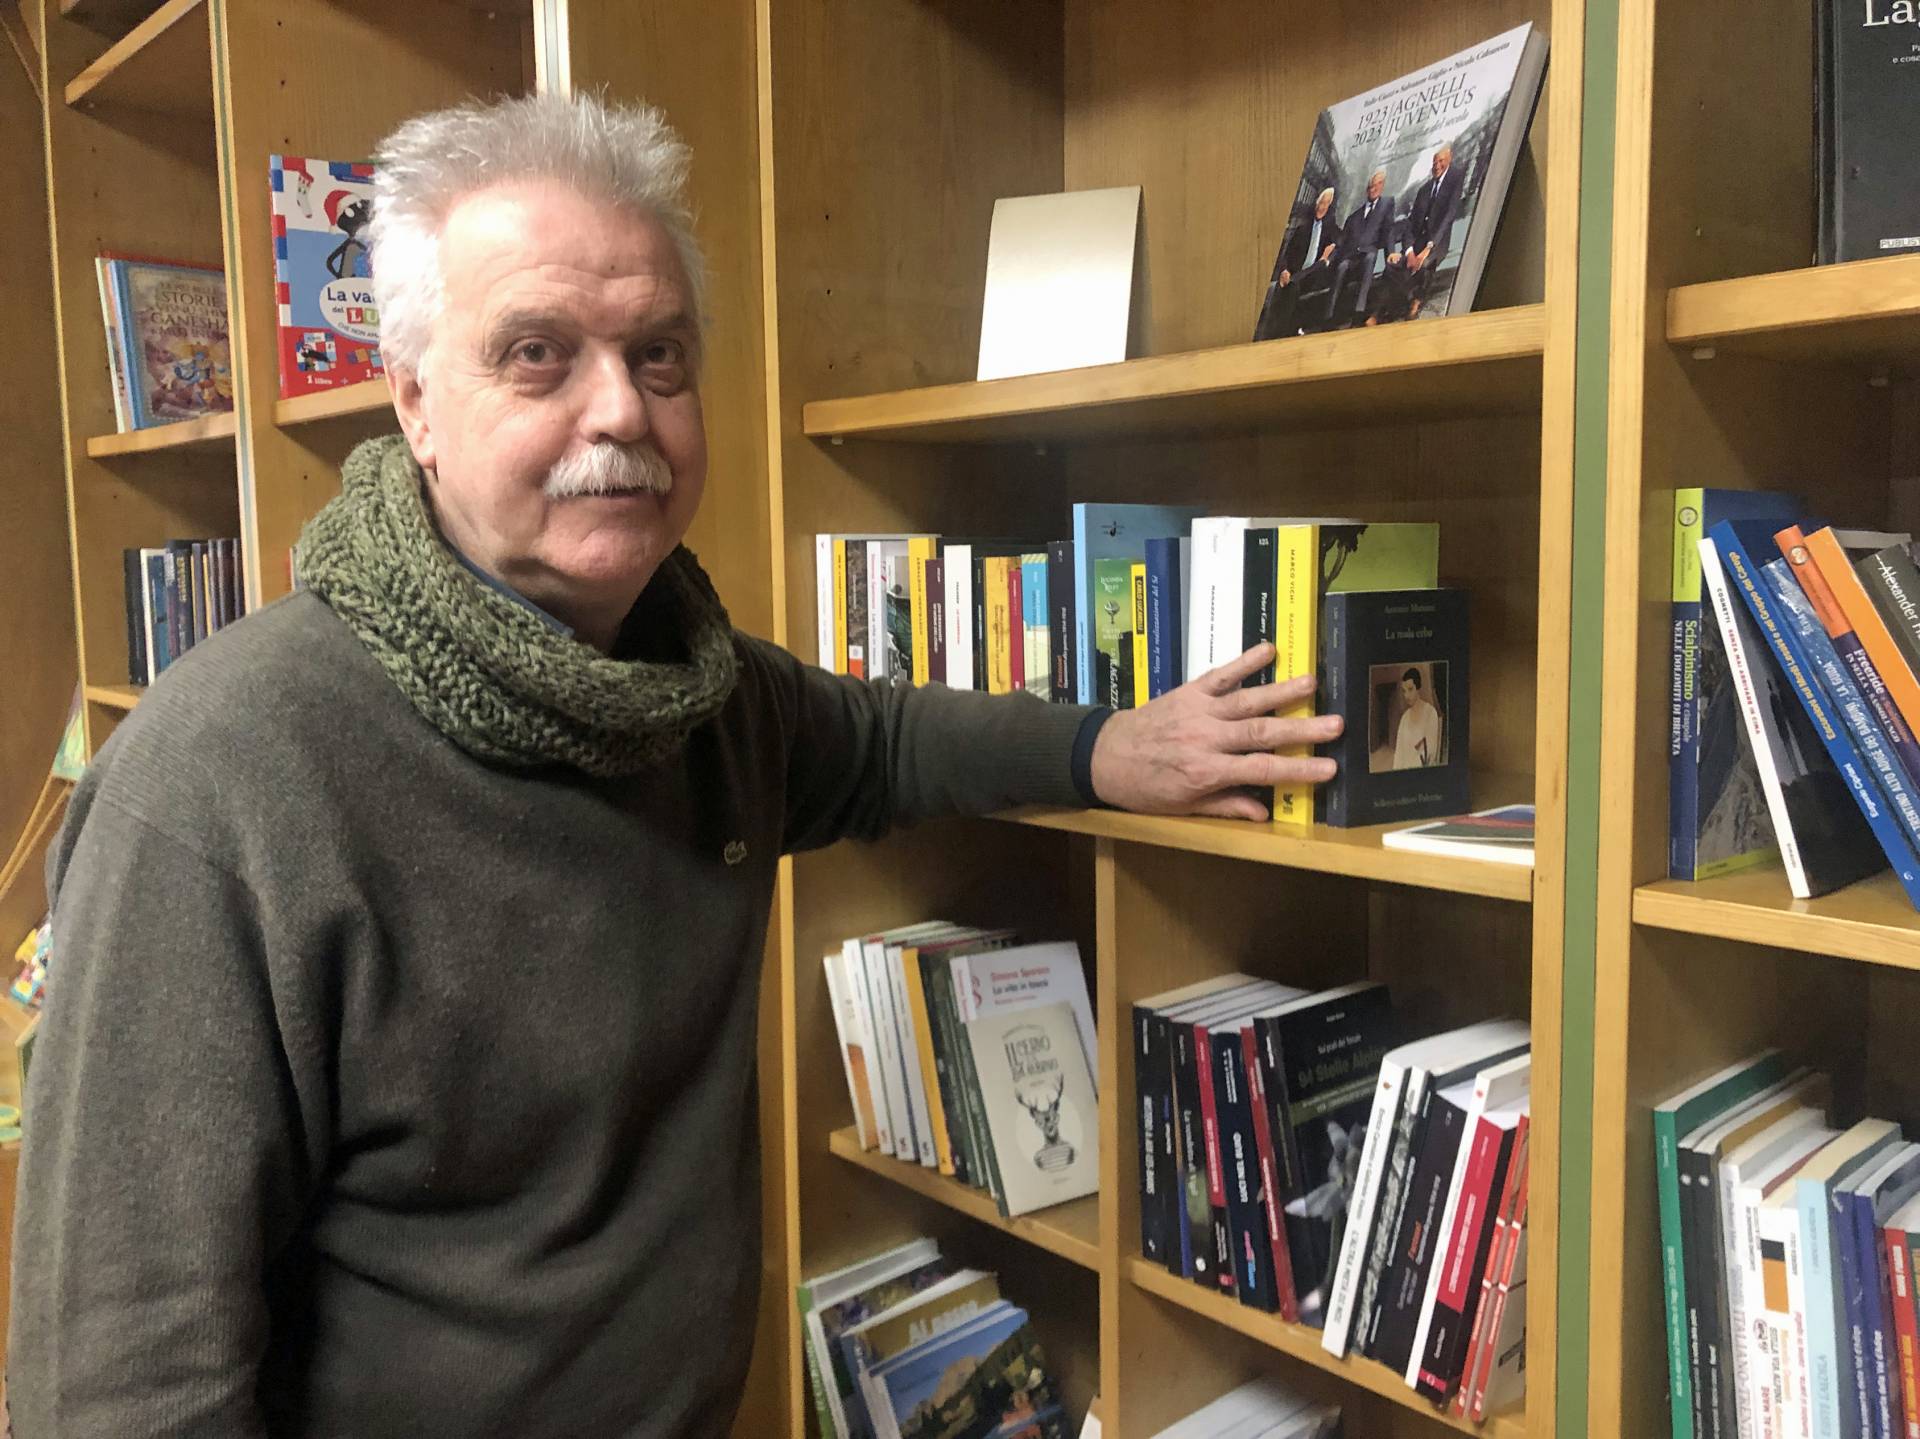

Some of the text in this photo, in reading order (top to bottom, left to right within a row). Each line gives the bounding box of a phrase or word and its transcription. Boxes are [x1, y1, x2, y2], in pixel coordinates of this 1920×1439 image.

[1862, 0, 1920, 28] La
[327, 287, 378, 304] La va
[351, 309, 379, 322] LU
[1748, 589, 1771, 620] Gruppo
[1878, 561, 1920, 622] Alexander
[1385, 626, 1433, 640] La mala erba
[1684, 620, 1698, 700] Scialpinismo
[1717, 587, 1730, 623] COGNETTI
[1728, 629, 1738, 654] SENZA
[1735, 654, 1743, 668] MAI
[1739, 670, 1753, 706] ARRIVARE
[1752, 716, 1761, 735] CIMA
[1849, 662, 1869, 689] SELLA
[1852, 647, 1887, 696] Freeride
[1672, 620, 1684, 756] NELLE DOLOMITI DI BRENTA
[1807, 697, 1836, 741] Escursioni
[1822, 660, 1920, 831] TRENTINO ALTO ADIGE DEI BAMBINI LA GUIDA
[1857, 787, 1880, 818] Eugenio
